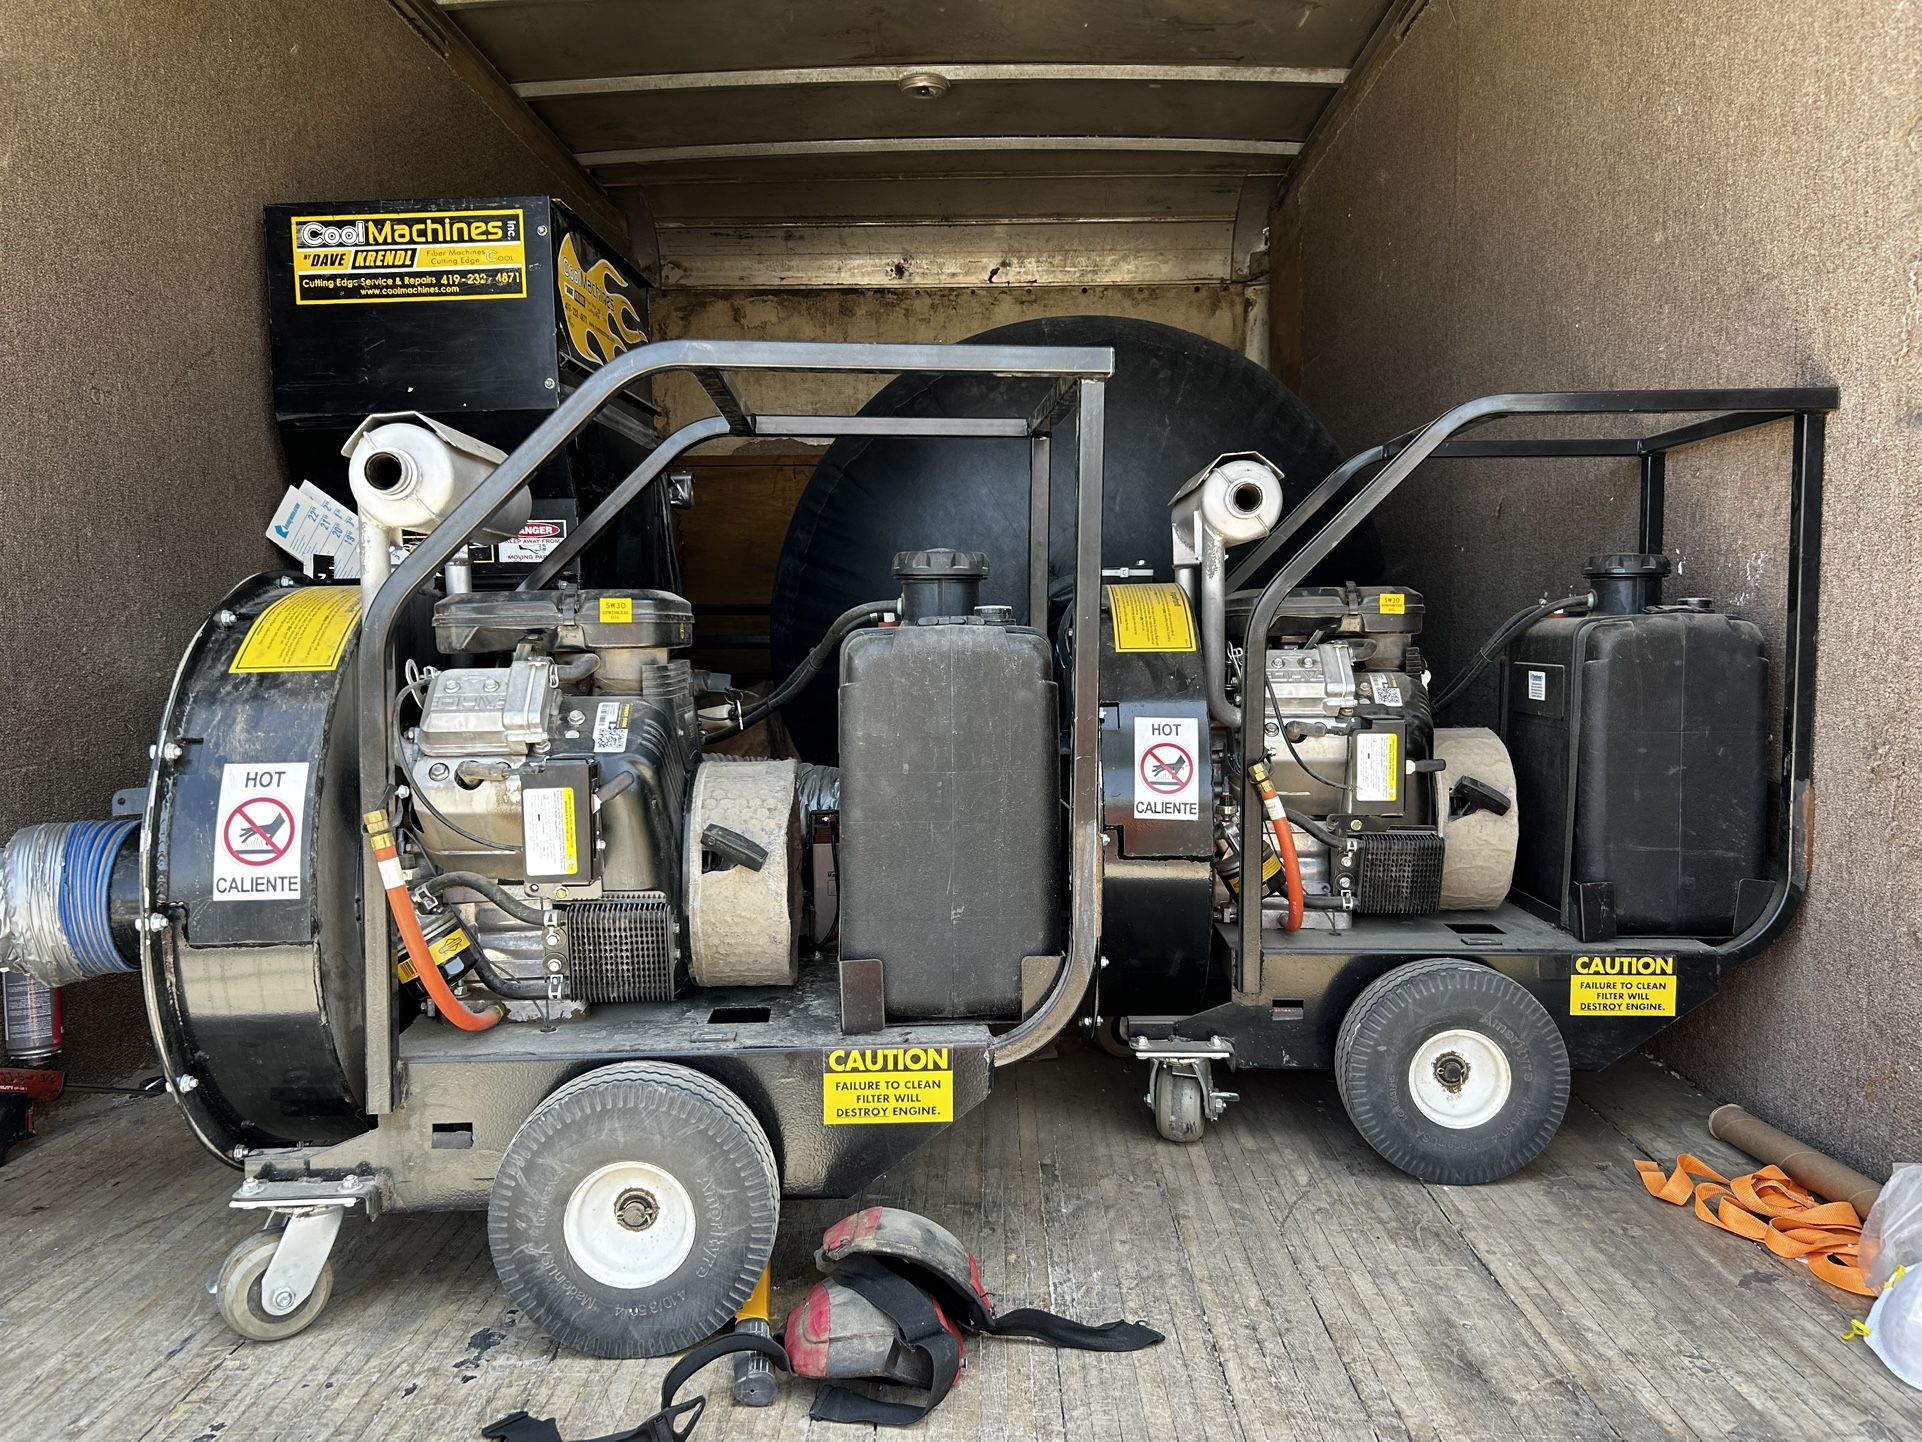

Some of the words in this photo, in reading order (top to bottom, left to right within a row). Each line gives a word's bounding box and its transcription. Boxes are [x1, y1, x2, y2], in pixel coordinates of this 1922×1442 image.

[311, 253, 347, 267] DAVE
[355, 250, 413, 267] KRENDL
[427, 249, 446, 257] Fiber
[448, 249, 486, 257] Machines
[431, 257, 458, 266] Cutting
[460, 257, 480, 265] Edge
[302, 279, 335, 289] Cutting
[361, 277, 394, 286] Service
[395, 277, 402, 285] &
[404, 276, 437, 287] Repairs
[360, 285, 460, 296] www.coolmachines.com
[519, 526, 553, 534] ANGER
[1151, 723, 1181, 736] HOT
[245, 771, 286, 788] HOT
[1136, 801, 1197, 815] CALIENTE
[216, 876, 298, 893] CALIENTE
[1575, 956, 1673, 975] CAUTION
[1580, 982, 1617, 990] FAILURE
[1620, 982, 1633, 990] TO
[1636, 982, 1667, 990] CLEAN
[1597, 992, 1624, 1000] FILTER
[1628, 992, 1650, 1000] WILL
[1580, 1003, 1623, 1011] DESTROY
[1626, 1003, 1665, 1011] ENGINE.
[829, 1048, 948, 1072] CAUTION
[835, 1081, 881, 1091] FAILURE
[885, 1081, 900, 1089] TO
[904, 1080, 941, 1089] CLEAN
[856, 1094, 890, 1104] FILTER
[894, 1093, 921, 1102] WILL
[836, 1107, 889, 1118] DESTROY
[892, 1106, 941, 1116] ENGINE.
